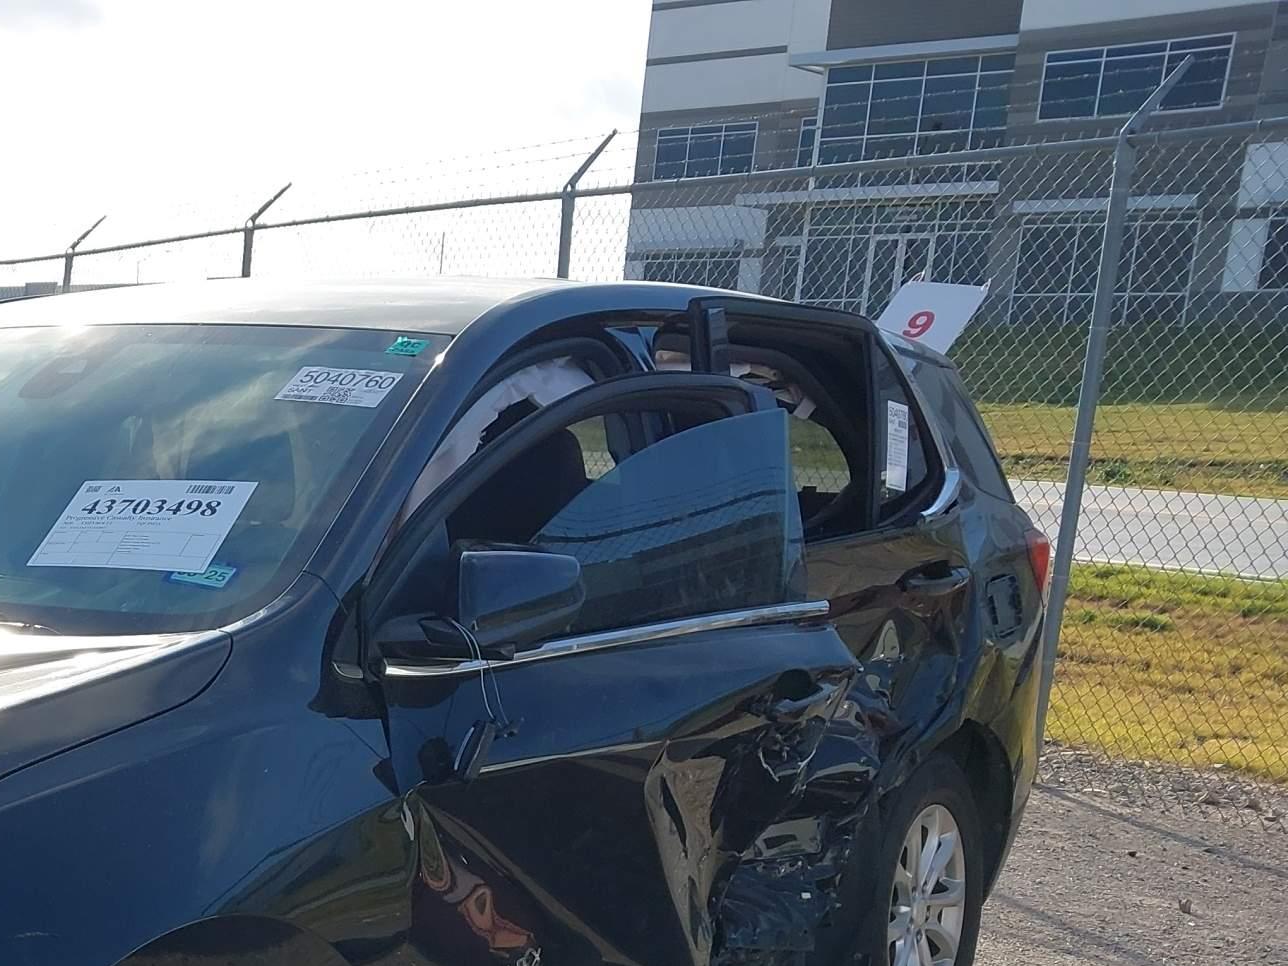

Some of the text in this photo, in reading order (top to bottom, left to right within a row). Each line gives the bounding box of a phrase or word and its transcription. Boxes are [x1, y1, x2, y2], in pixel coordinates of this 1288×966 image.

[902, 310, 936, 338] 9
[298, 370, 397, 390] 5040760
[81, 498, 222, 517] 43703498
